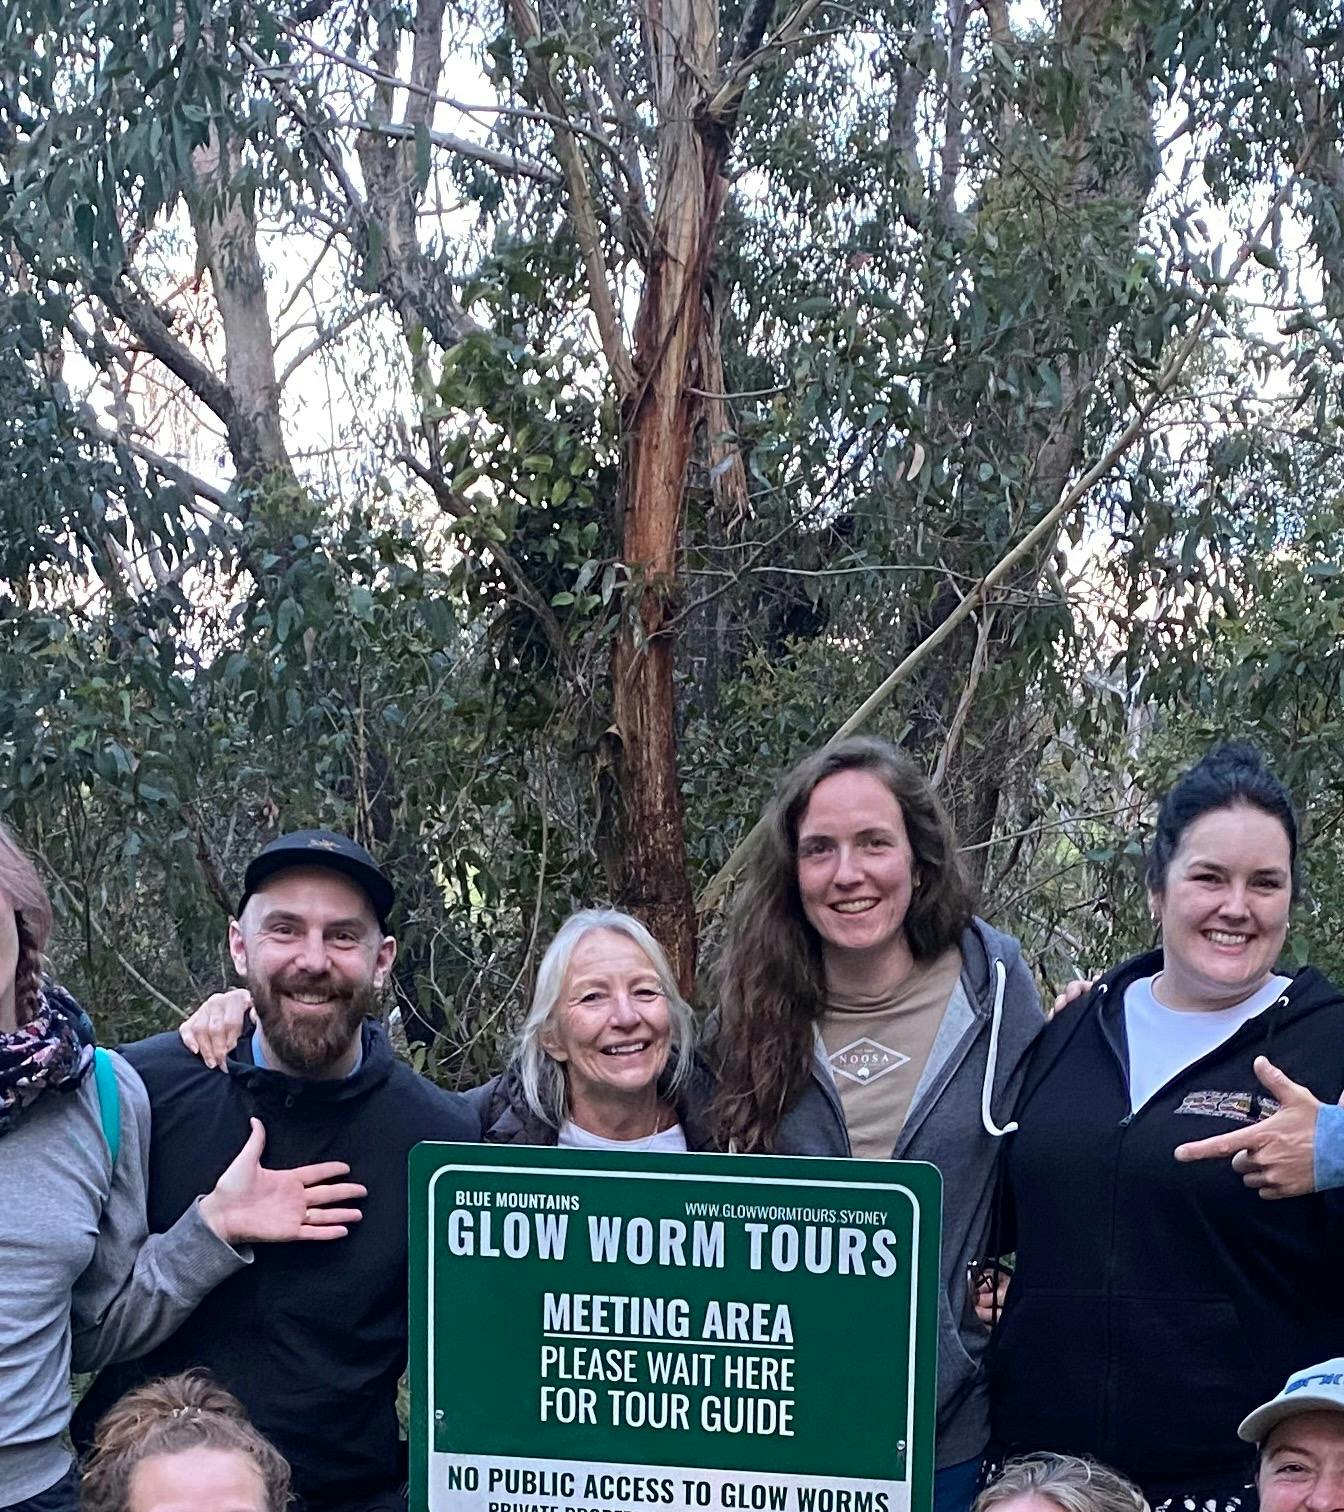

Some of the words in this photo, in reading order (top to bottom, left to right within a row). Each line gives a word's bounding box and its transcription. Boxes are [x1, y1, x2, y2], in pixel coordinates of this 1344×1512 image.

[839, 1054, 889, 1064] NOOSA
[455, 1191, 491, 1208] BLUE
[495, 1193, 580, 1211] MOUNTAINS
[685, 1203, 888, 1225] WWW.GLOWWORMTOURS.SYDNEY
[448, 1210, 569, 1260] GLOW
[588, 1216, 725, 1267] WORM
[745, 1224, 897, 1277] TOURS
[544, 1293, 690, 1339] MEETING
[702, 1301, 794, 1343] AREA
[541, 1346, 637, 1382] PLEASE
[647, 1351, 715, 1386] WAIT
[725, 1356, 794, 1391] HERE
[540, 1387, 597, 1424] FOR
[608, 1391, 690, 1429] TOUR
[701, 1396, 794, 1436] GUIDE
[448, 1466, 479, 1492] NO
[488, 1468, 575, 1498] PUBLIC
[584, 1474, 673, 1504] ACCESS
[683, 1480, 711, 1507] TO
[721, 1483, 788, 1512] GLOW
